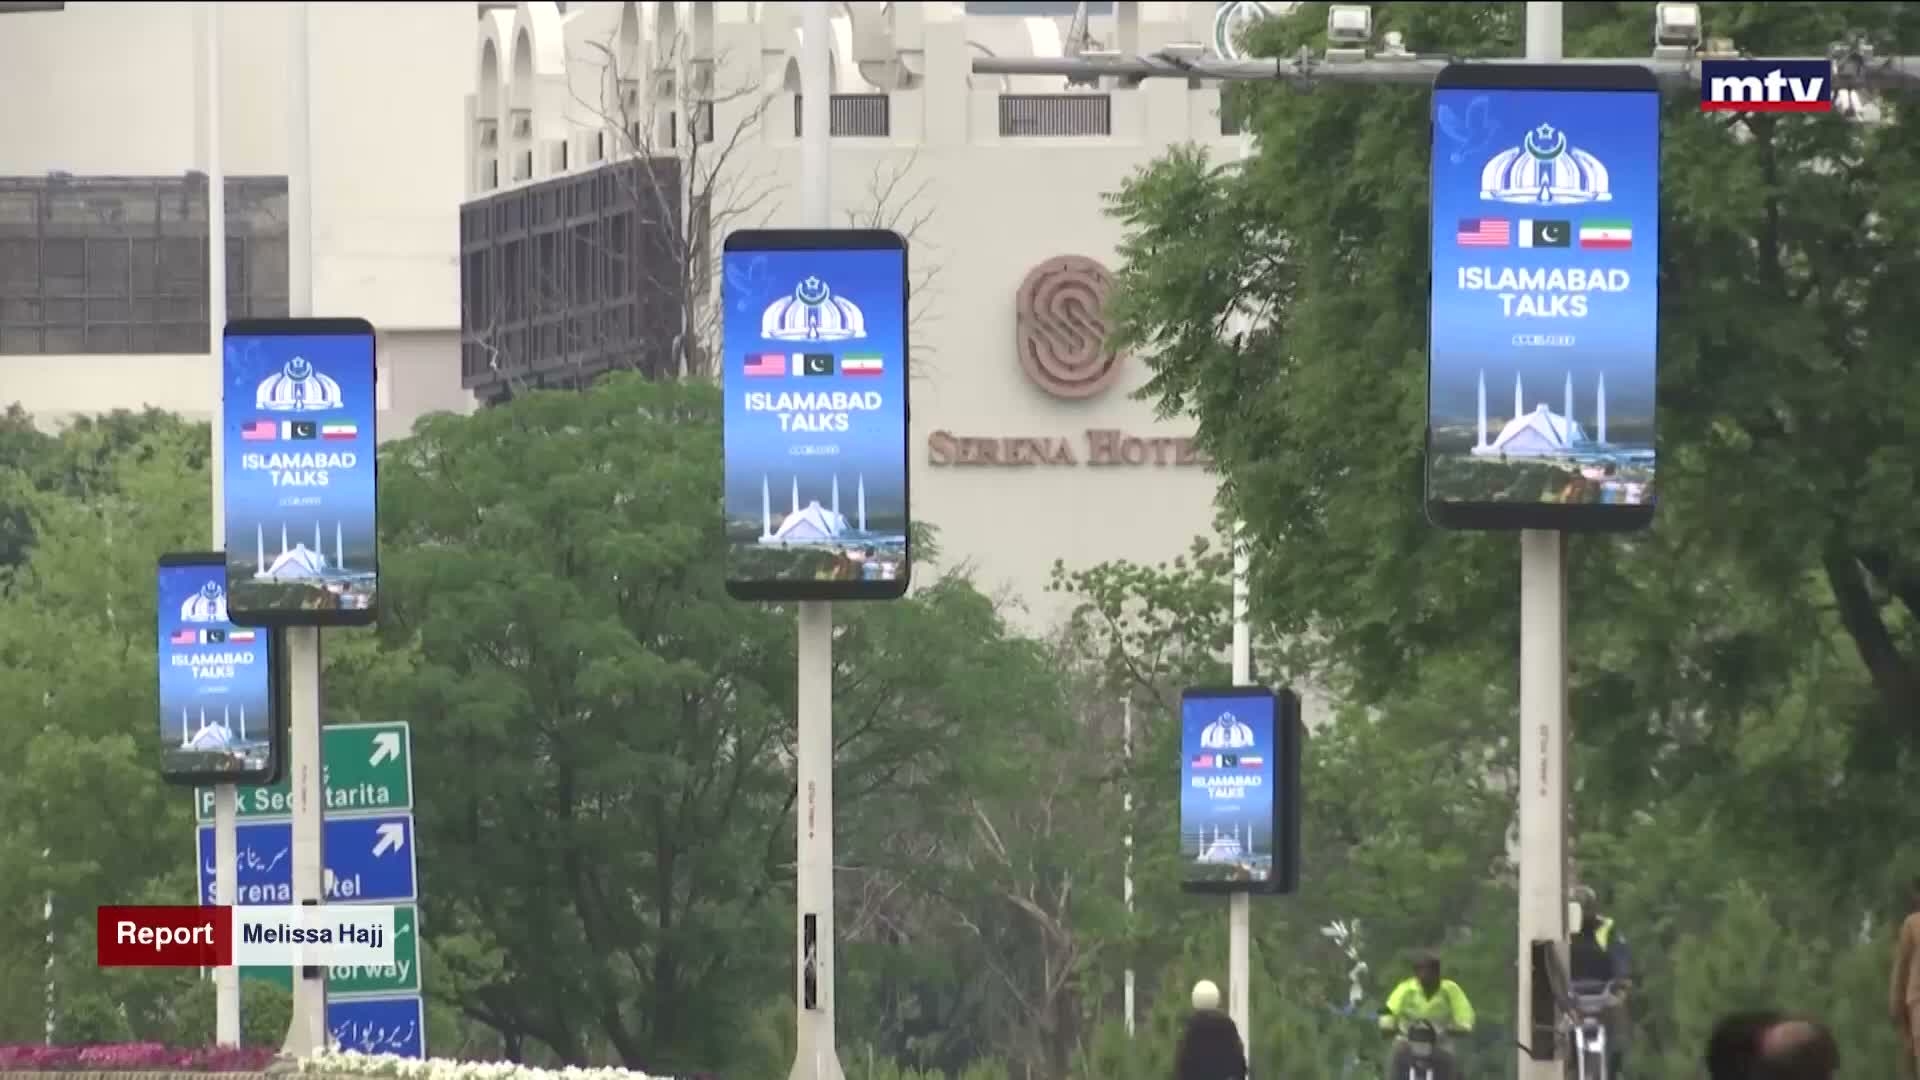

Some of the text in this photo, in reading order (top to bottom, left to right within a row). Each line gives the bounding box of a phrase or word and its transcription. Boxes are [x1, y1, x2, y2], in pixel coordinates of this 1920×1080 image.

[1457, 266, 1630, 292] ISLAMABAD
[1498, 293, 1588, 317] TALKS
[745, 391, 881, 411] ISLAMABAD
[778, 412, 849, 432] TALKS
[1086, 429, 1202, 467] HOTE
[242, 452, 356, 470] ISLAMABAD
[271, 471, 329, 486] TALKS
[171, 651, 255, 666] ISLAMABAD
[192, 666, 235, 679] TALKS
[203, 790, 246, 813] Pk
[255, 782, 390, 811] Sectarita
[208, 881, 291, 905] Srena
